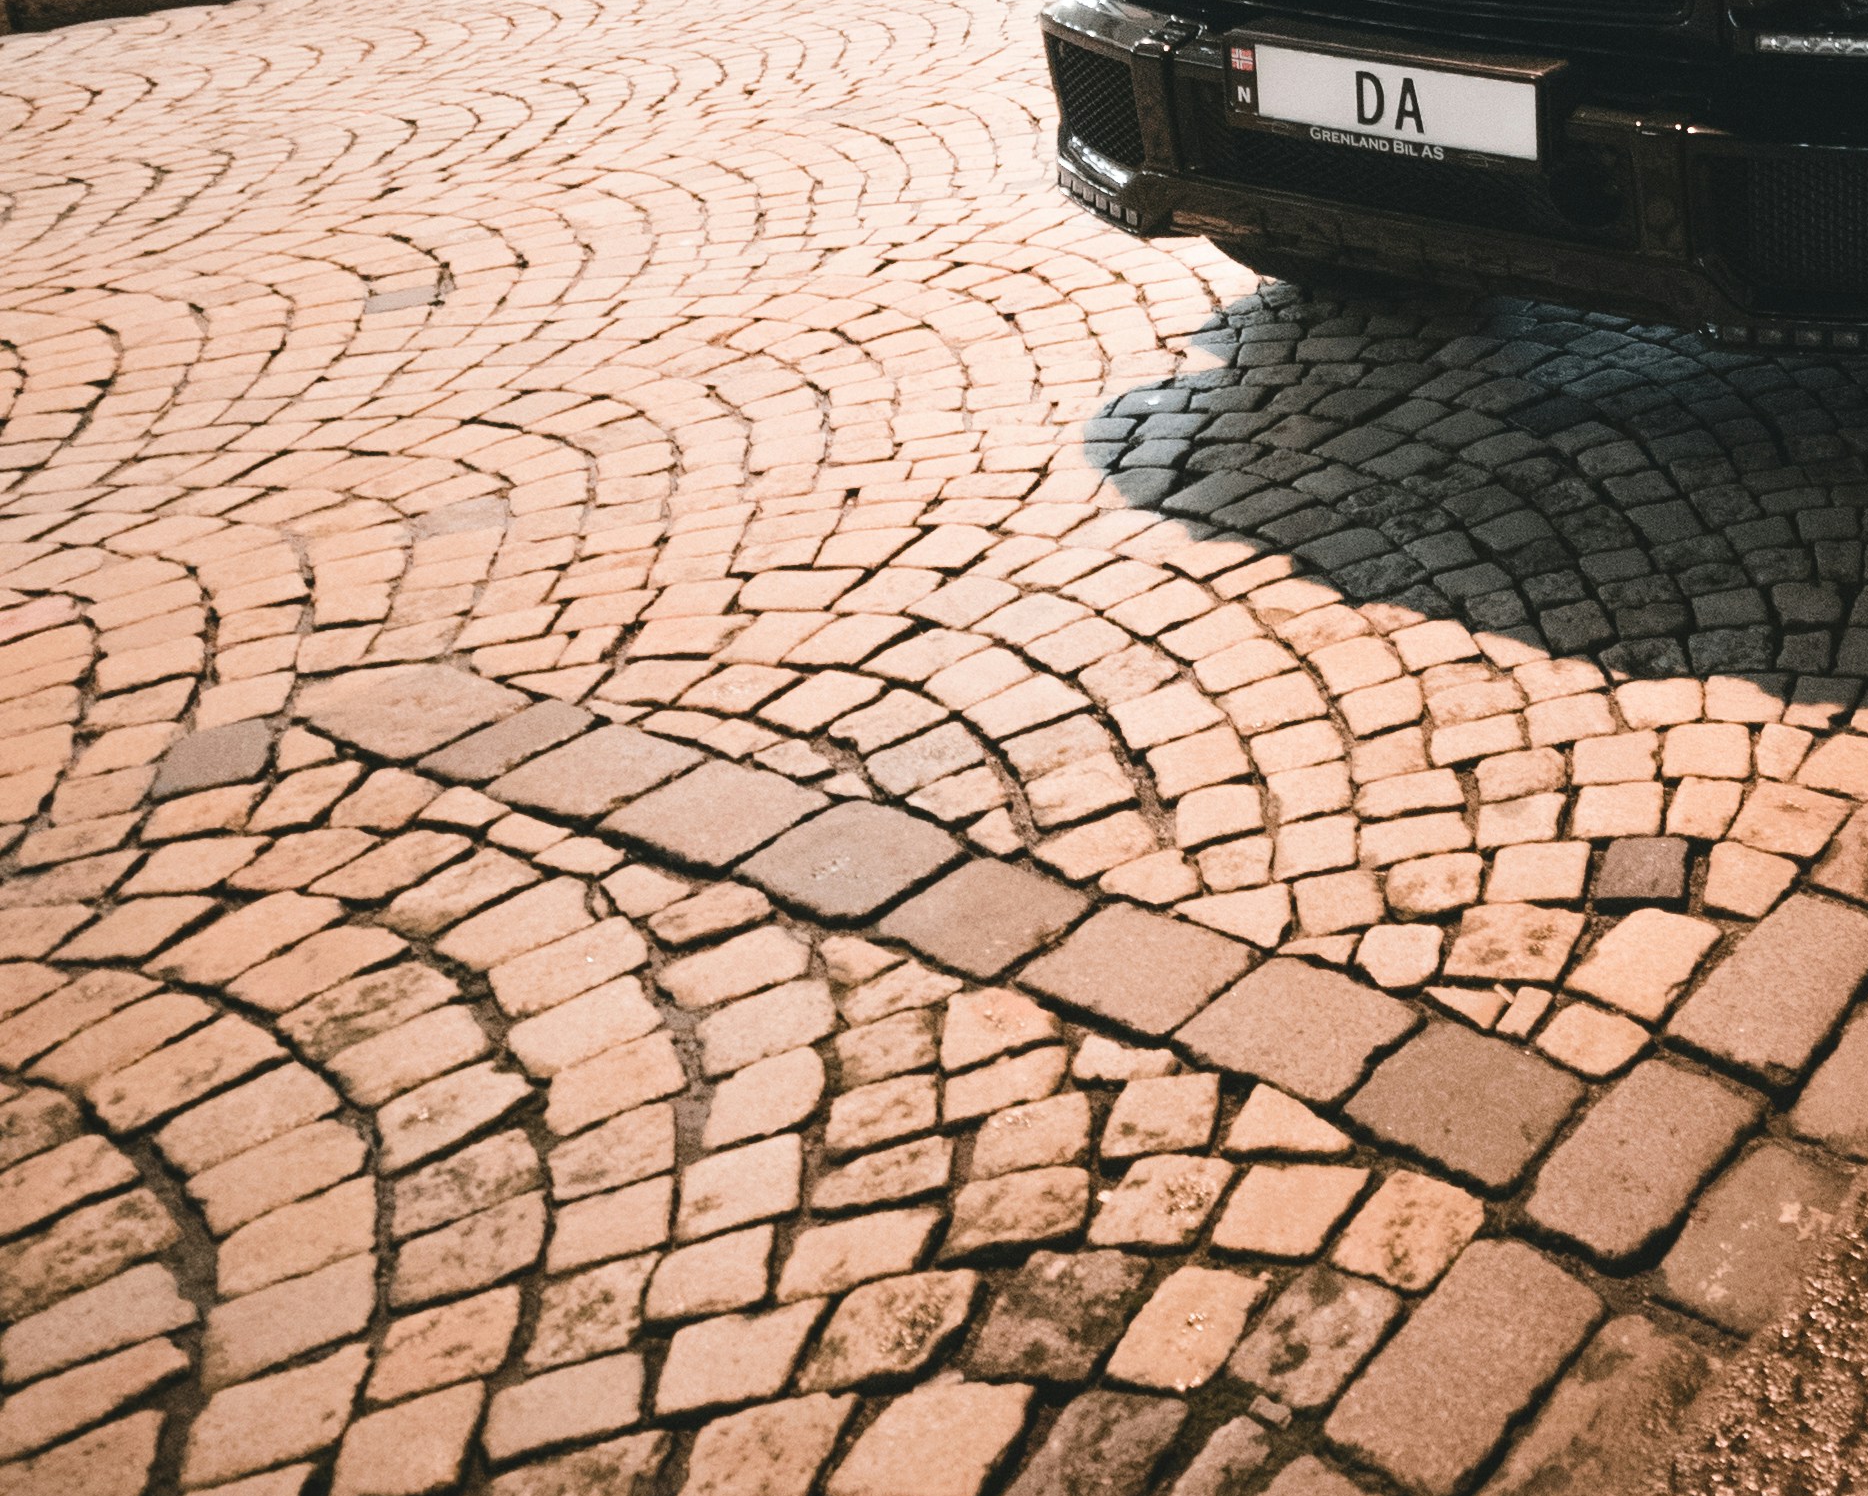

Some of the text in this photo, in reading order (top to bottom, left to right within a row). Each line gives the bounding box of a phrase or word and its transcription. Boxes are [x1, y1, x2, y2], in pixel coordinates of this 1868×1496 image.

[1237, 85, 1251, 104] N
[1355, 70, 1425, 134] DA
[1309, 126, 1445, 161] GRENLAND BIL AS
